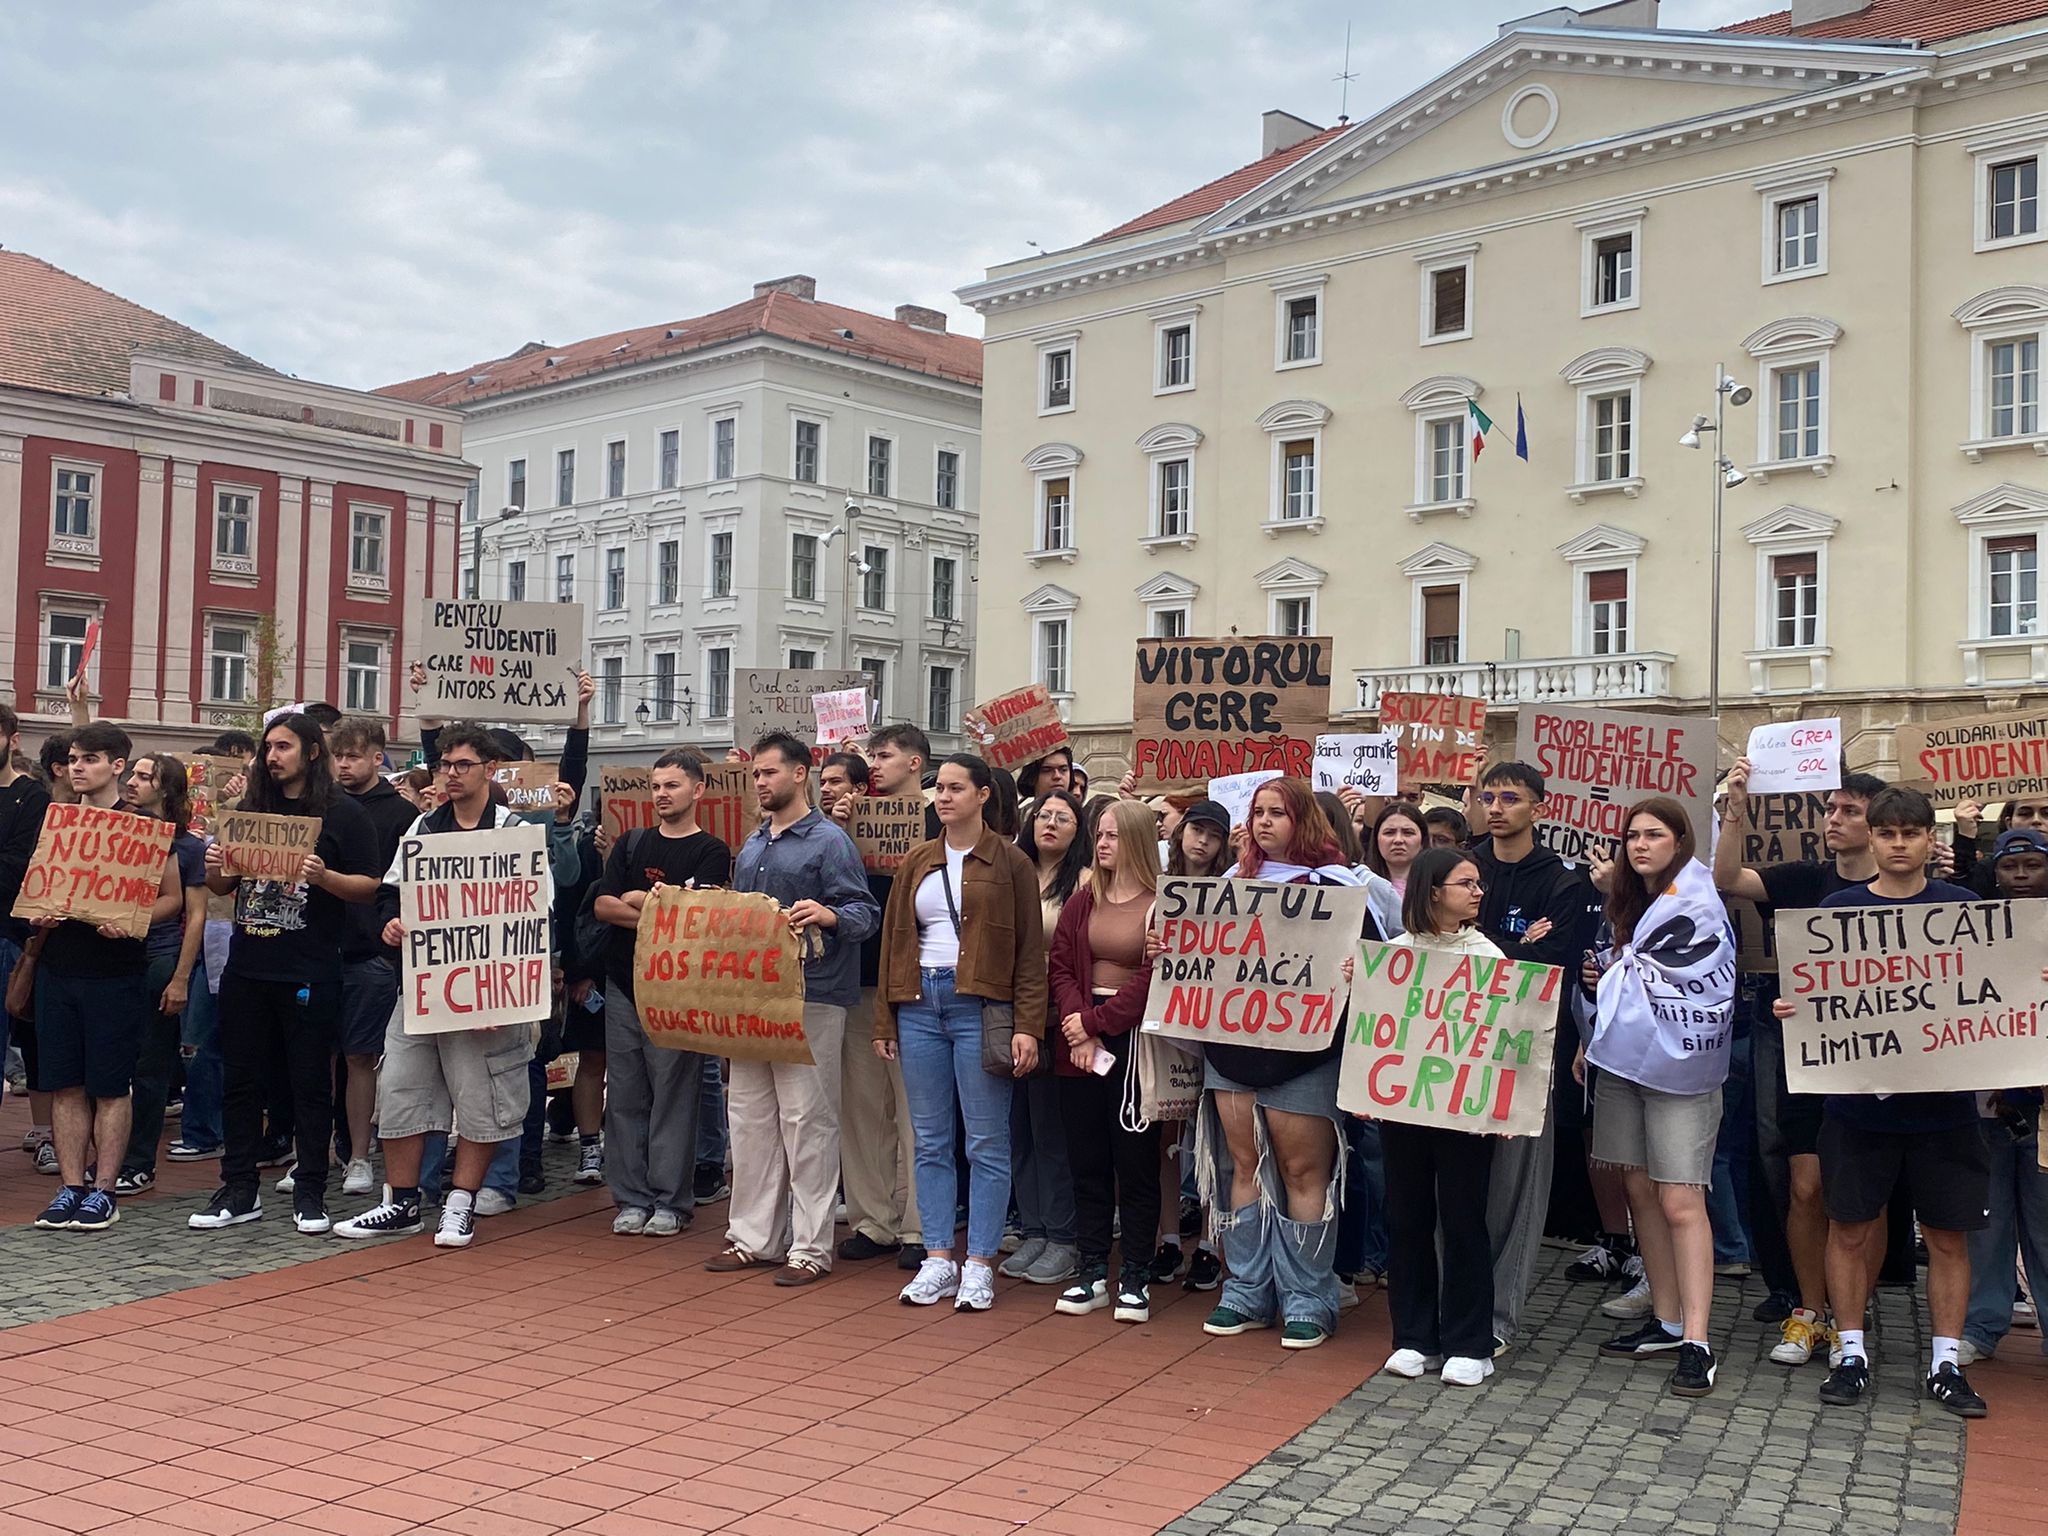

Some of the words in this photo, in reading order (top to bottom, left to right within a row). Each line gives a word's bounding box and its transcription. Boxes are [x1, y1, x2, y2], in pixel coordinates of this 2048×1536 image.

[434, 602, 502, 628] PENTRU
[464, 628, 557, 656] STUDENȚII
[427, 655, 463, 672] CARE
[470, 656, 494, 676] NU
[500, 659, 532, 678] S-AU
[748, 672, 781, 693] Cred
[1138, 642, 1330, 688] VIITORUL
[438, 675, 496, 699] ÎNTORS
[503, 681, 567, 707] ACASĂ
[1165, 691, 1282, 733] CERE
[1381, 693, 1485, 730] SCUZELE
[1381, 724, 1404, 738] NU
[1409, 722, 1445, 748] ȚIN
[1455, 729, 1476, 747] DE
[1534, 714, 1684, 763] PROBLEMELE
[1791, 730, 1833, 747] GREA
[1926, 725, 1996, 748] SOLIDARI
[1320, 771, 1333, 788] în
[1537, 744, 1697, 798] STUDENȚILOR
[1797, 758, 1828, 773] GOL
[856, 799, 870, 815] VĂ
[876, 798, 904, 815] PASĂ
[908, 801, 920, 815] DE
[1935, 787, 1955, 801] NU
[1958, 783, 1984, 799] POT
[1988, 781, 2002, 797] FI
[47, 831, 101, 864] NU
[101, 832, 168, 869] SUNT
[402, 840, 474, 882] PENTRU
[479, 851, 521, 879] TINE
[531, 851, 543, 876] E
[417, 883, 450, 922] UN
[461, 877, 539, 918] NUMĂR
[1162, 879, 1332, 920] STATUL
[410, 924, 490, 968] PENTRU
[502, 917, 547, 956] MINE
[1923, 900, 2014, 947] CÂȚI
[643, 950, 690, 982] JOS
[701, 947, 782, 983] FACE
[1161, 957, 1216, 981] DOAR
[1235, 954, 1313, 987] DACĂ
[1361, 944, 1428, 987] VOI
[1443, 954, 1561, 1006] AVEȚI
[1792, 947, 1964, 994] STUDENȚI
[416, 972, 431, 1016] E
[444, 958, 543, 1013] CHIRIA
[1808, 982, 1936, 1023] TRĂIESC
[1957, 977, 2001, 1006] LA
[645, 1006, 736, 1039] BUGETUL
[1164, 985, 1213, 1030] NU
[1219, 986, 1337, 1035] COSTĂ
[1404, 987, 1510, 1026] BUGET
[1350, 1011, 1410, 1050] NOI
[1425, 1021, 1534, 1065] AVEM
[1801, 1030, 1902, 1067] LIMITA
[1368, 1054, 1517, 1121] GRIJI
